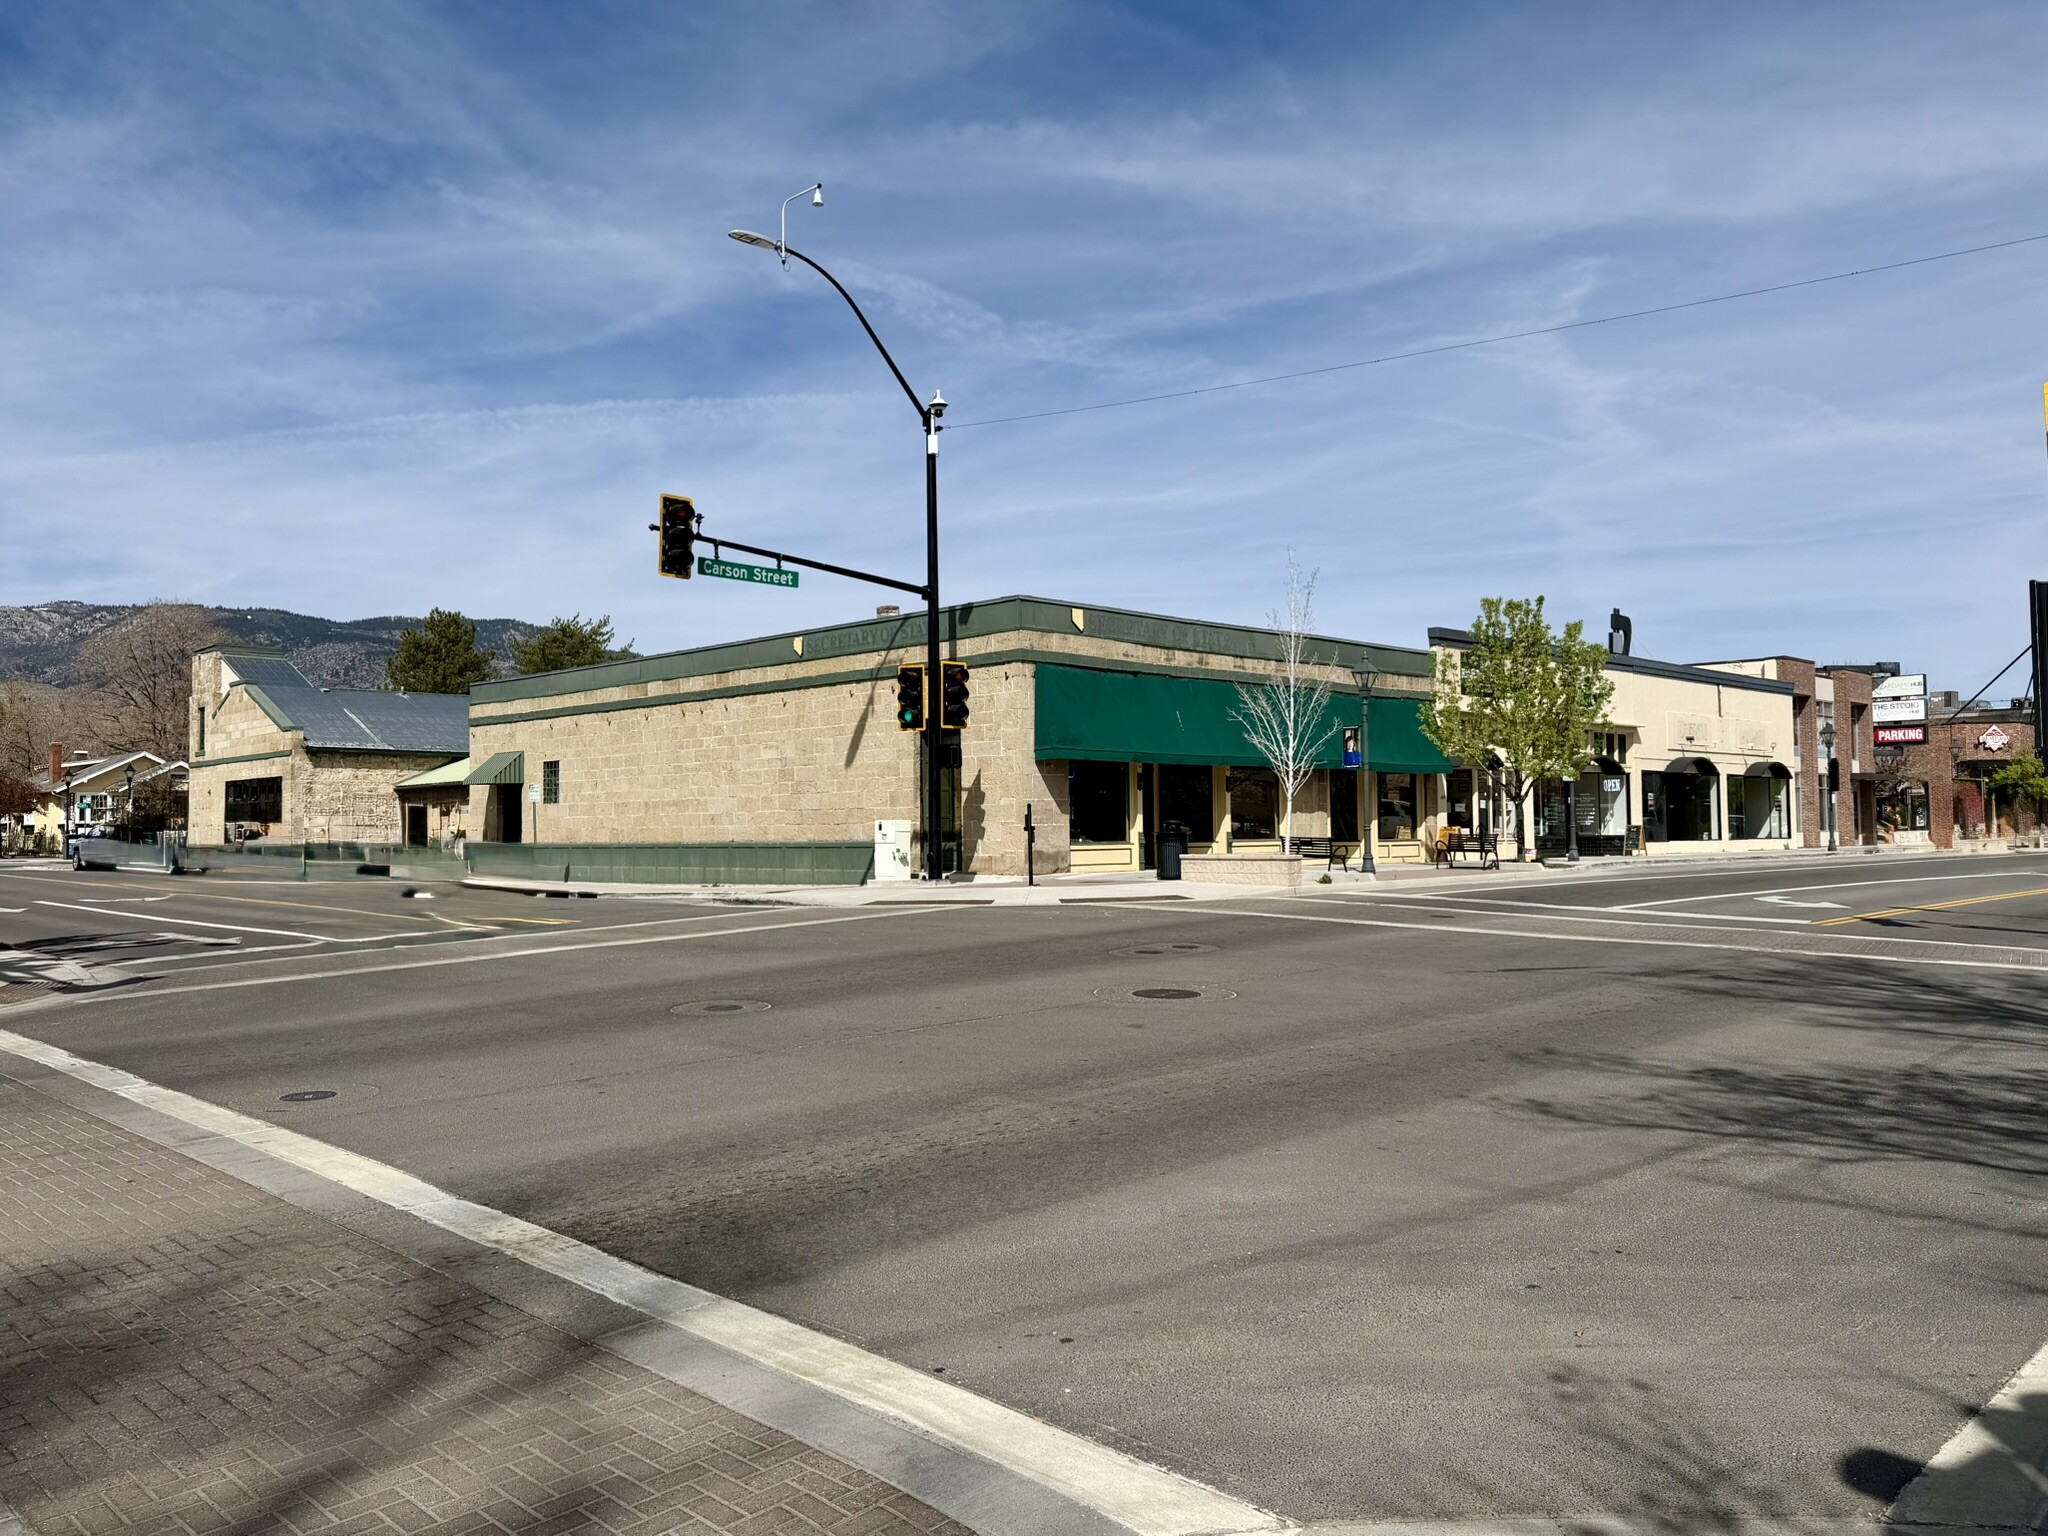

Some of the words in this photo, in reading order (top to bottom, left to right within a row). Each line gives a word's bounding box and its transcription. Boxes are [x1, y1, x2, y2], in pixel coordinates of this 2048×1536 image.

[703, 560, 748, 579] Carson
[752, 568, 793, 585] Street
[1873, 703, 1888, 711] THE
[1890, 701, 1920, 710] STUDIO
[1878, 729, 1923, 741] PARKING
[1603, 778, 1621, 792] OPEN
